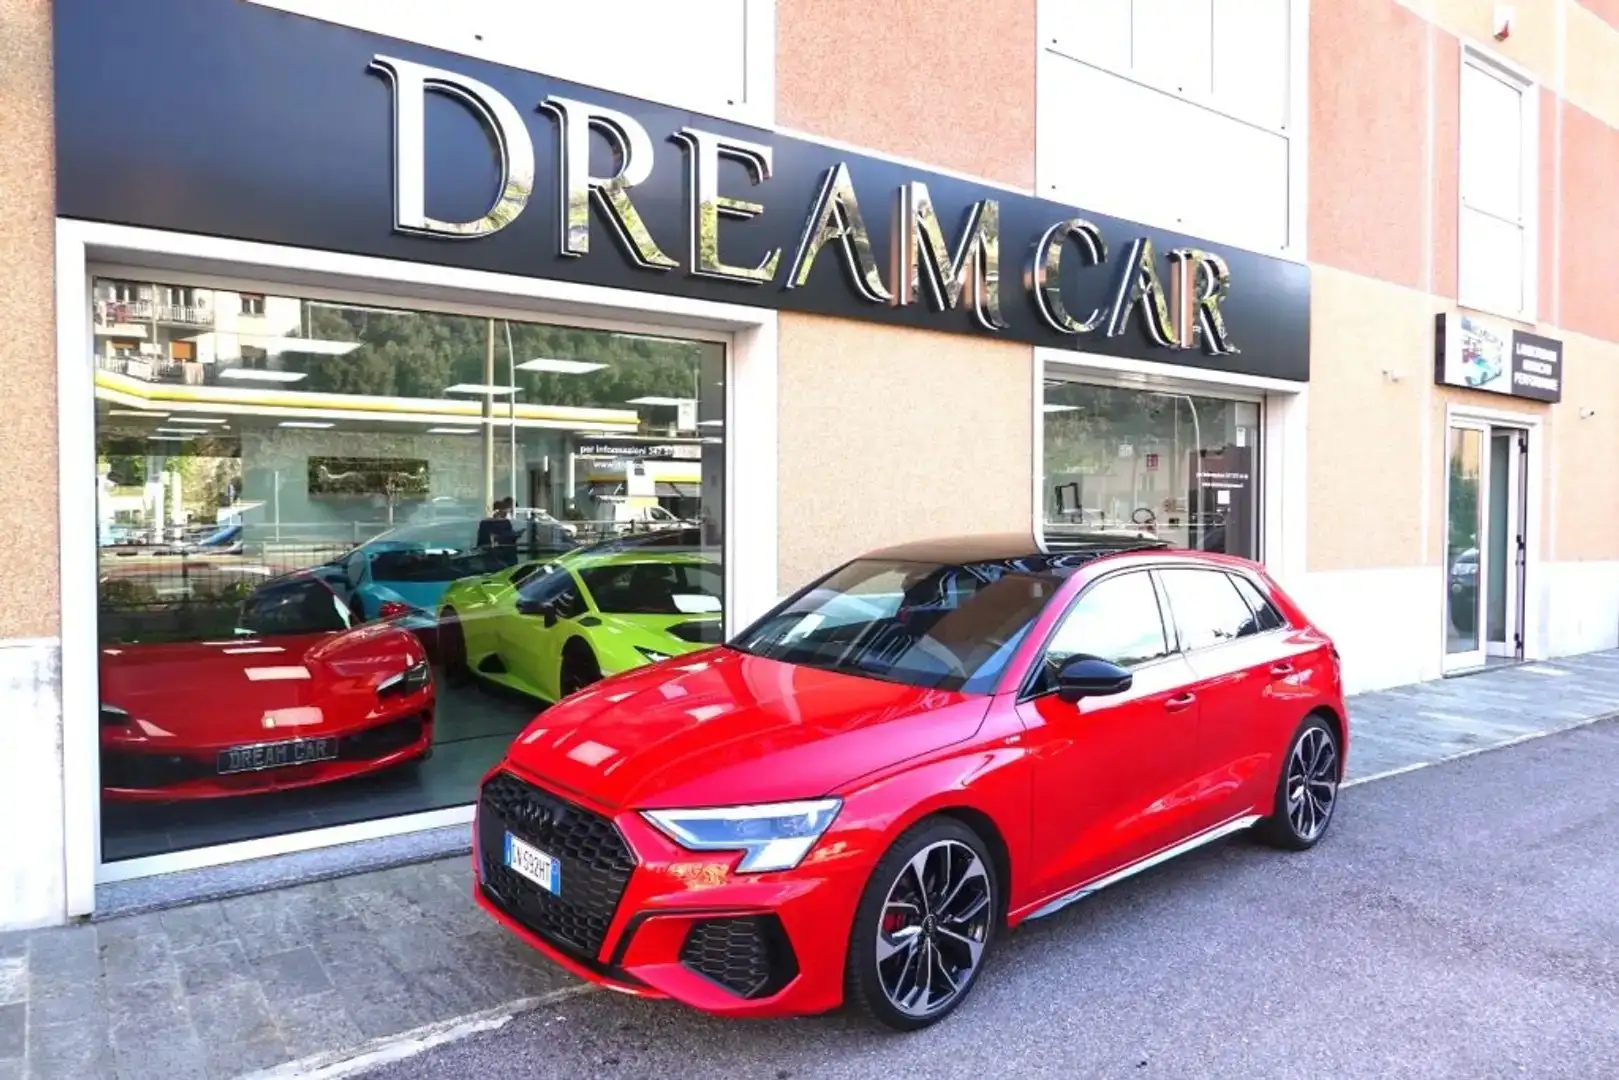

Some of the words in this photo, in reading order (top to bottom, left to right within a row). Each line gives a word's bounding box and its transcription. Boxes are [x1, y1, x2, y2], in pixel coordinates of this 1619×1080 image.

[367, 53, 1008, 331] DREAM
[1030, 217, 1241, 356] CAR
[228, 745, 287, 770] DREAM
[294, 739, 327, 761] CAR
